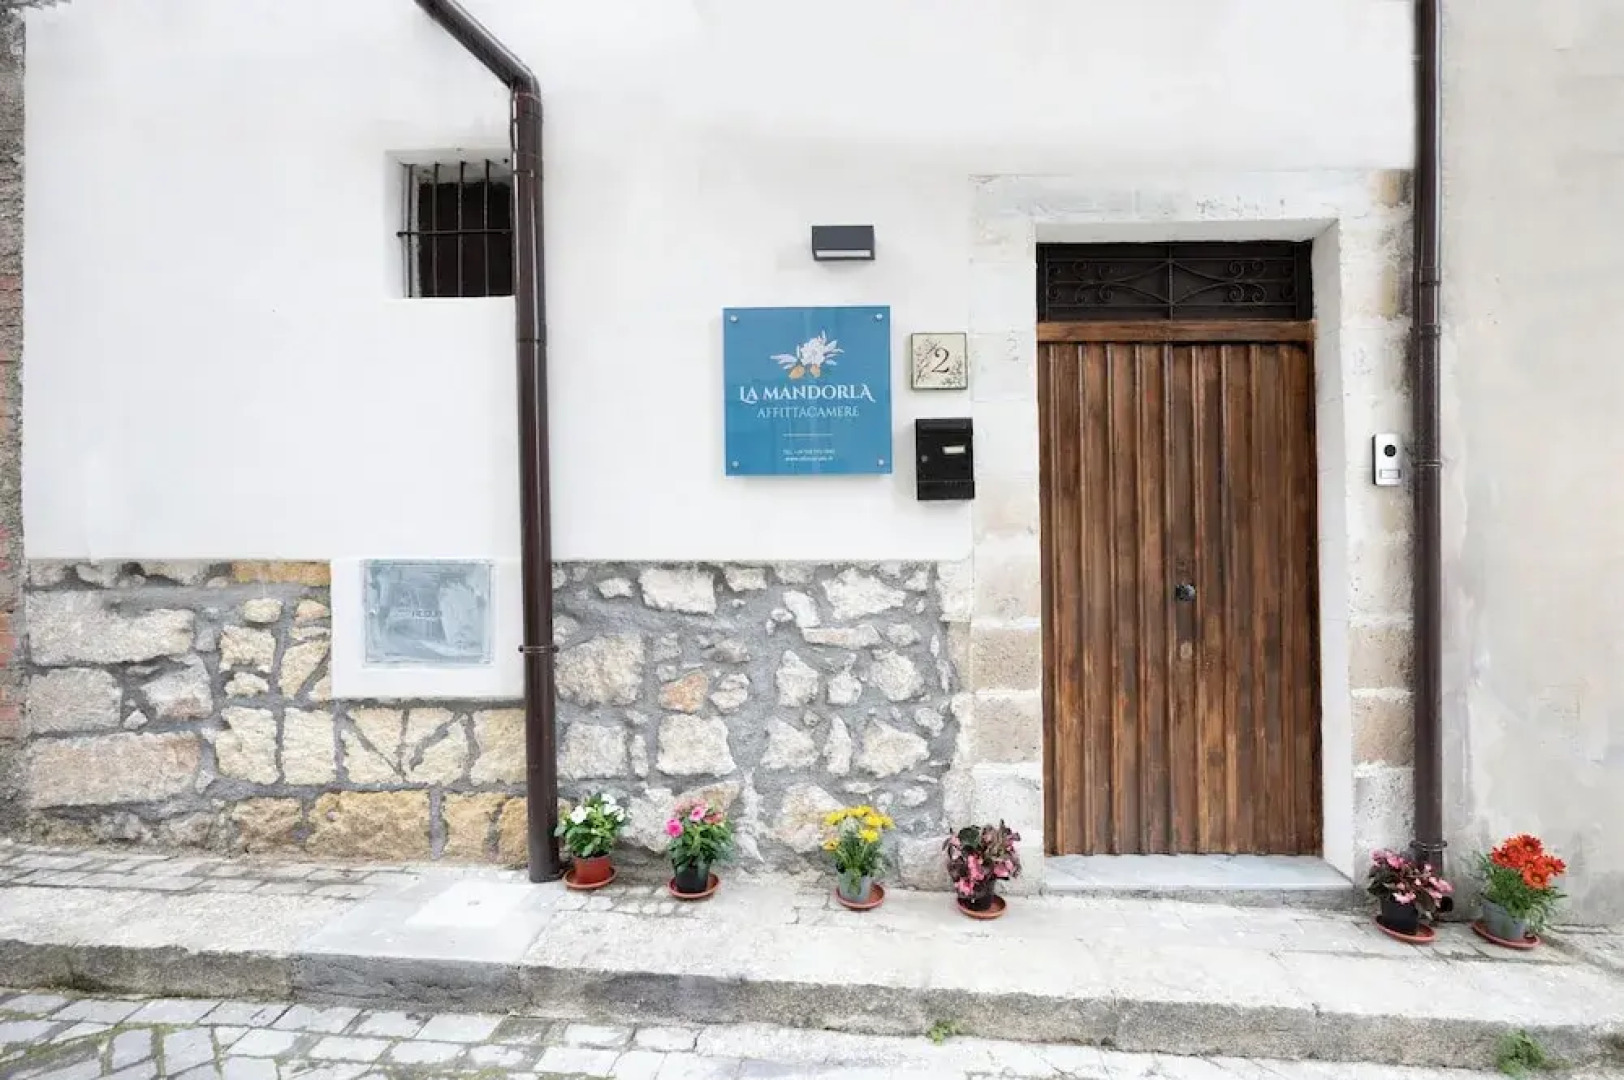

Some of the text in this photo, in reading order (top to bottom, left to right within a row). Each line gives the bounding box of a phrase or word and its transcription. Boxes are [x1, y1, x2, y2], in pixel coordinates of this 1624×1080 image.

[931, 347, 950, 373] 2
[739, 384, 876, 405] LA MANDORLA
[757, 405, 860, 418] AFFITTACAMERE
